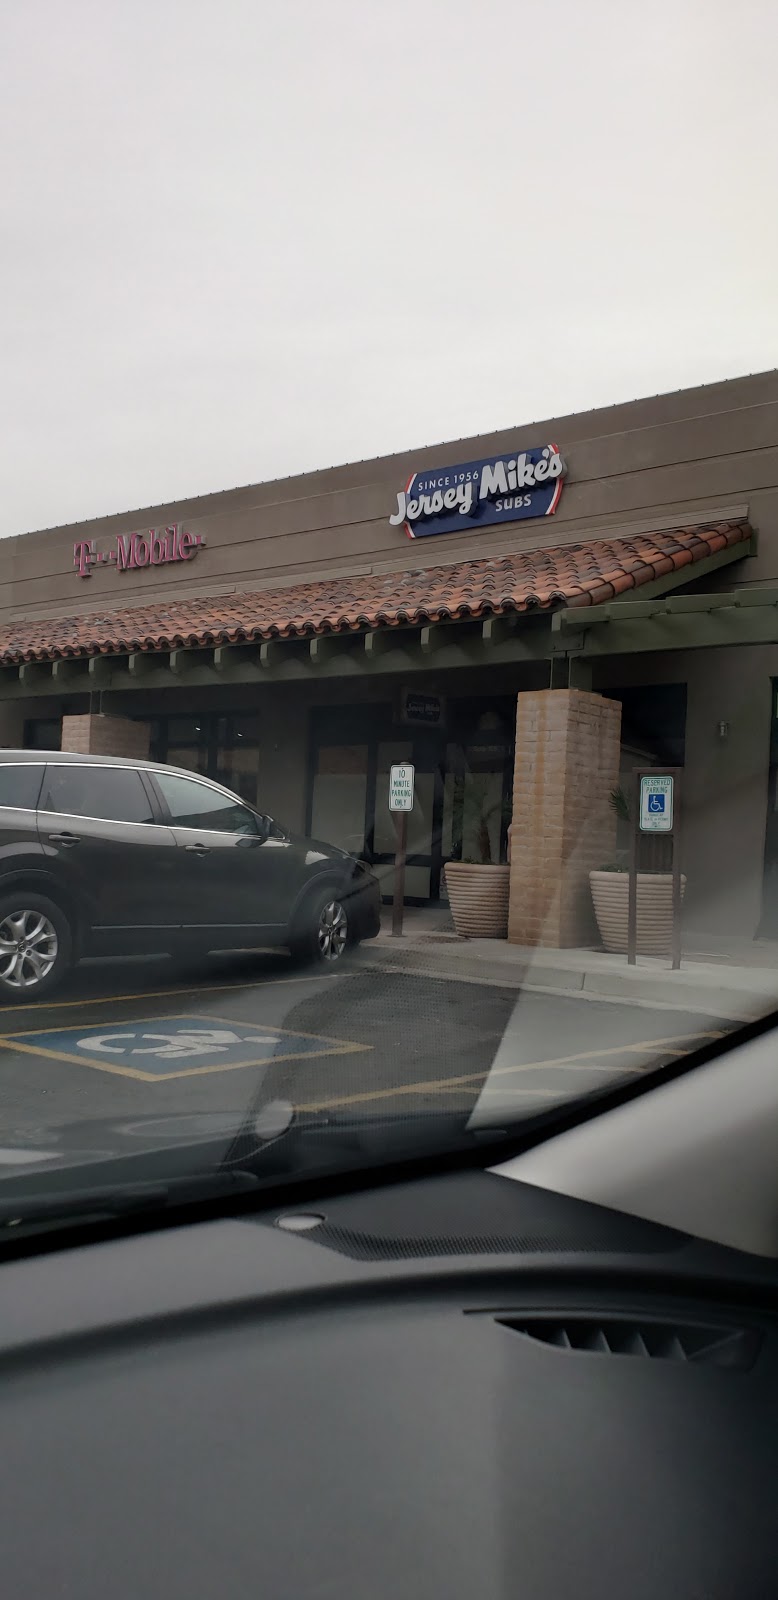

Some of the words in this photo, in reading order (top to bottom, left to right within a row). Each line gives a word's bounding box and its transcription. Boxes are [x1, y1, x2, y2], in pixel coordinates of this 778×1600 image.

[418, 477, 450, 491] SINCE
[453, 470, 479, 484] 1956
[389, 481, 473, 526] Jersey
[479, 448, 563, 500] Mike's
[495, 493, 532, 512] SUBS
[398, 769, 406, 778] 10
[393, 780, 410, 788] MINUTE
[391, 789, 412, 797] PARKING
[646, 786, 668, 794] PARKING
[394, 798, 407, 806] ONLY
